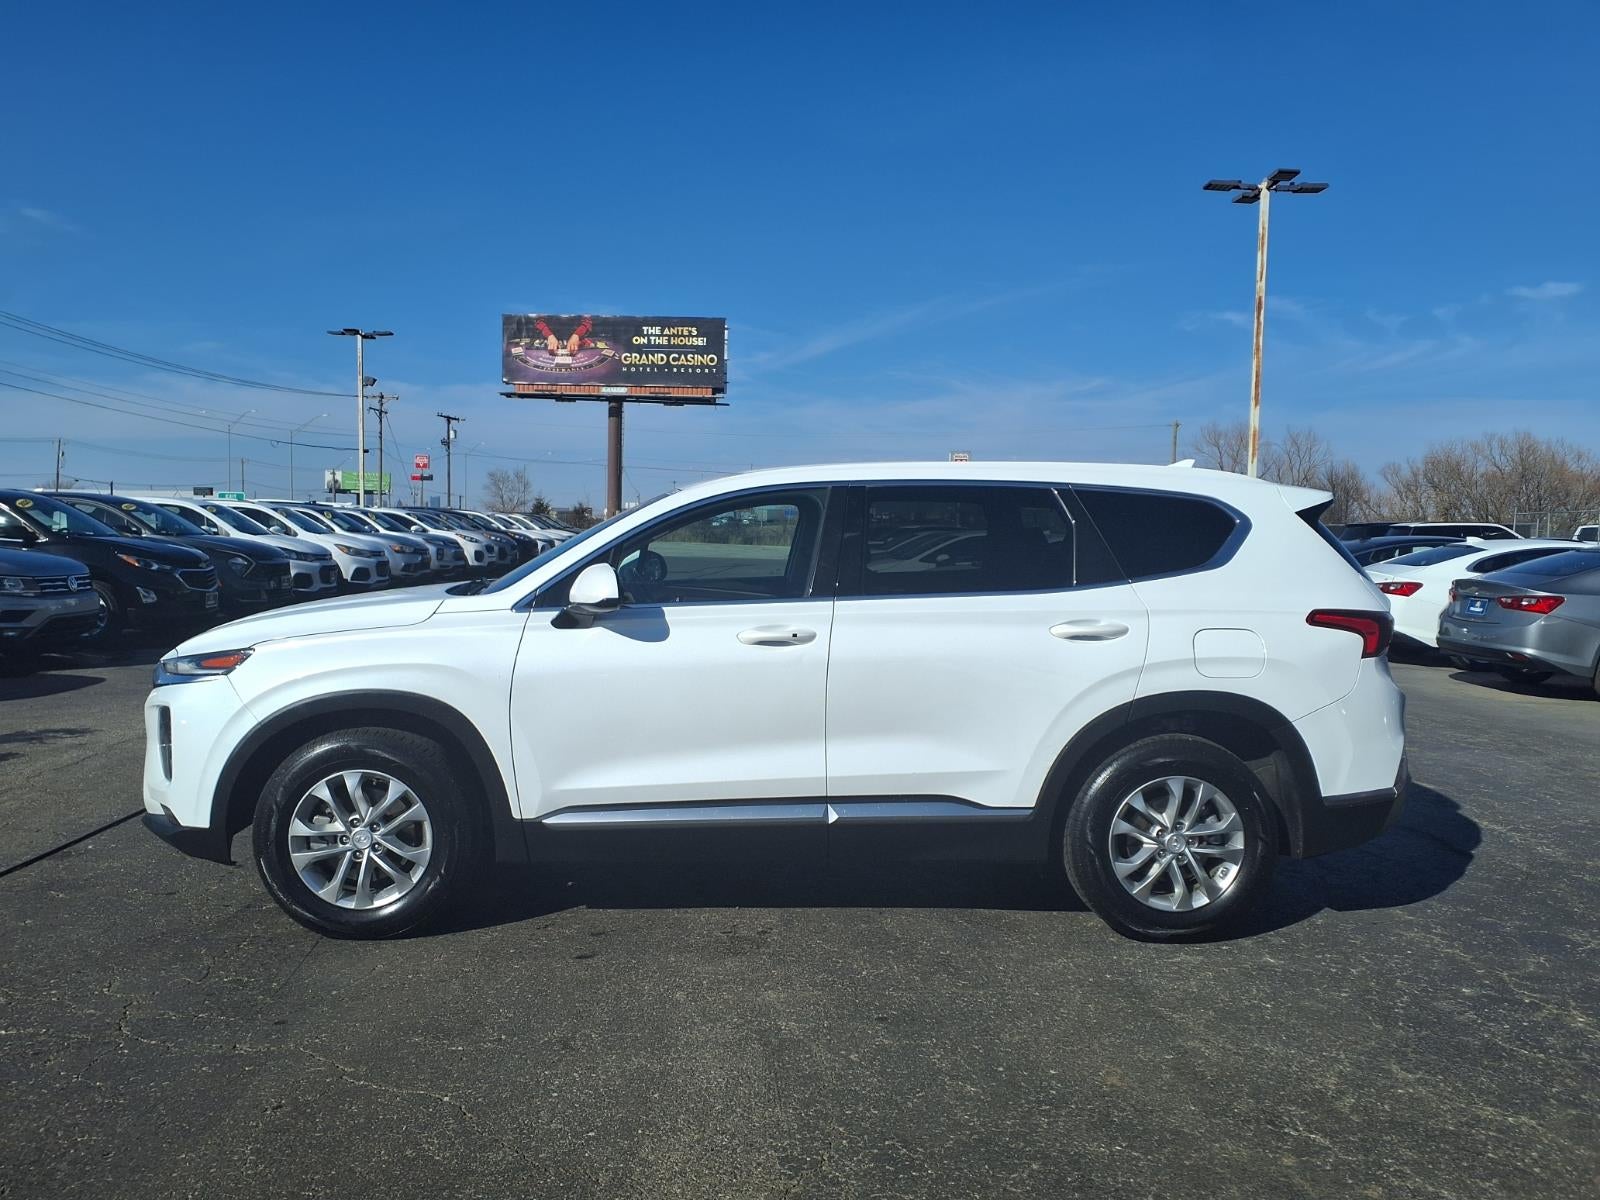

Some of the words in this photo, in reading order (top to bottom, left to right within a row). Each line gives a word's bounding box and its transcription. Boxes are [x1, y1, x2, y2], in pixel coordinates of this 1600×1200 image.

[642, 326, 662, 335] THE
[663, 326, 698, 336] ANTE'S
[632, 336, 648, 345] ON
[649, 336, 669, 345] THE
[670, 337, 707, 346] HOUSE!
[621, 352, 667, 365] GRAND
[669, 353, 718, 366] CASINO
